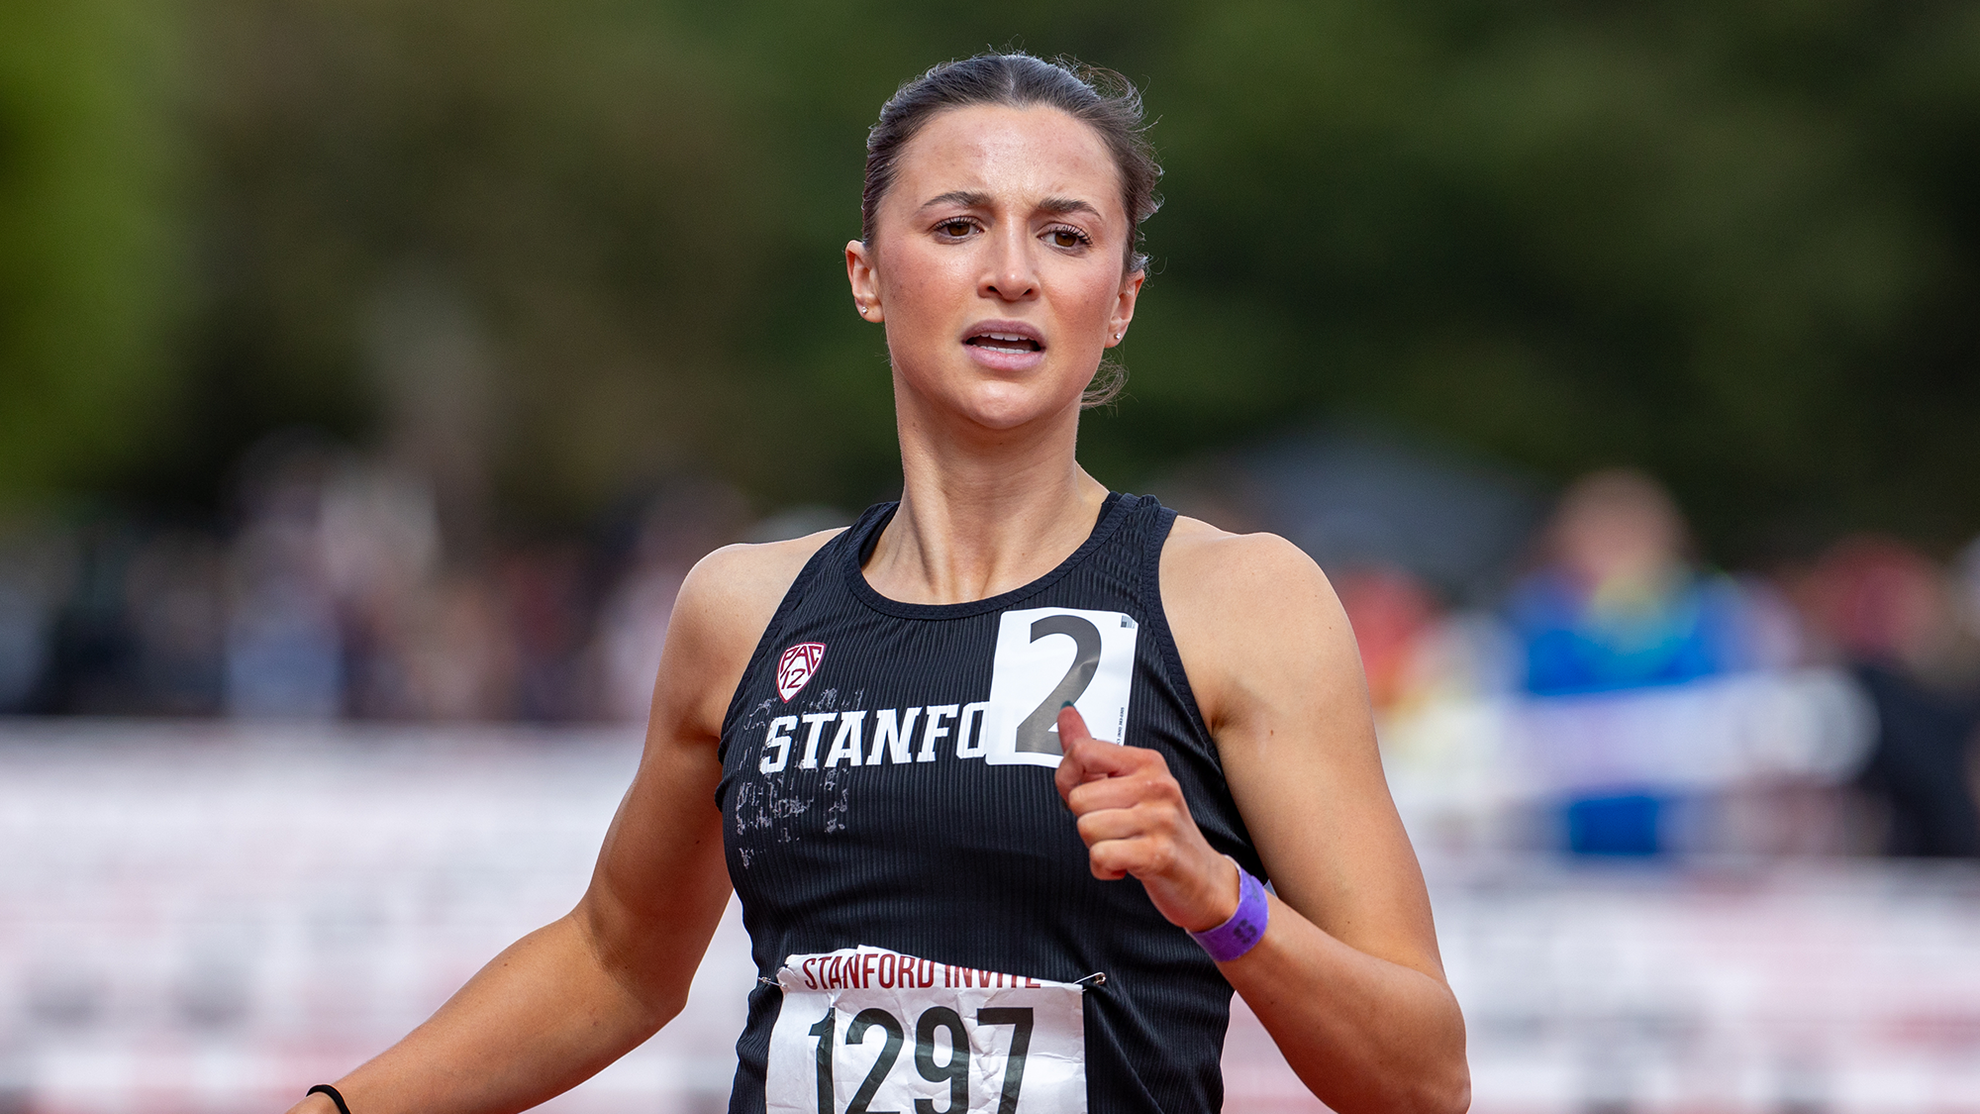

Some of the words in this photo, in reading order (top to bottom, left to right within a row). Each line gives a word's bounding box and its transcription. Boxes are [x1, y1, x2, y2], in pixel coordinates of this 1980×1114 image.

[780, 645, 822, 680] PAC
[781, 668, 806, 690] 12
[1015, 614, 1102, 756] 2
[803, 953, 935, 989] STANFORD
[945, 964, 1041, 989] INV
[808, 1006, 1034, 1114] 1297
